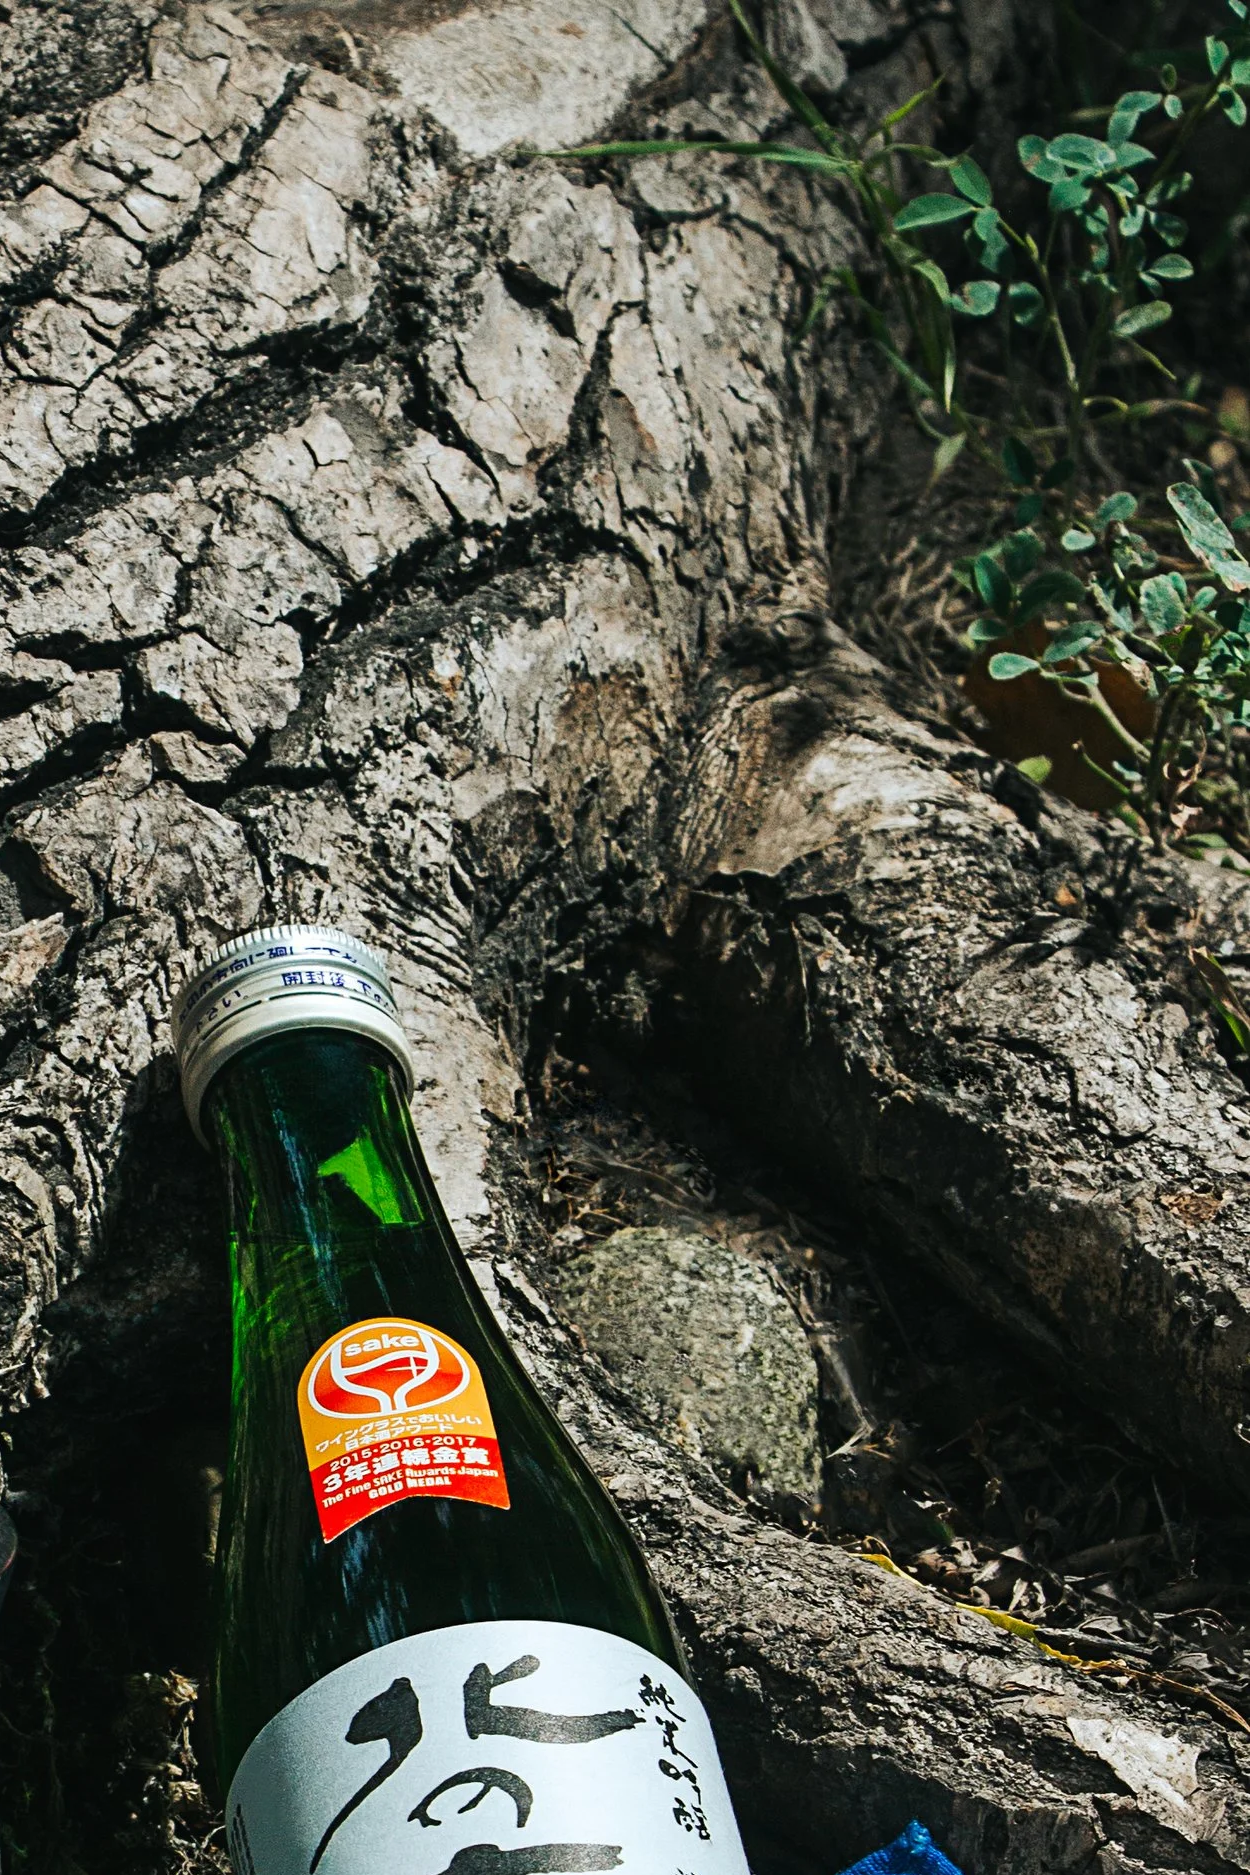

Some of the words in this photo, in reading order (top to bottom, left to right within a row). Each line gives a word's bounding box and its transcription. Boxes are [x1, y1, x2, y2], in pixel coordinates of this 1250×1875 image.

[344, 1334, 420, 1357] sake
[315, 1413, 482, 1453] ワイングラスでおいしい
[344, 1423, 454, 1451] 日本酒アワード
[322, 1491, 344, 1508] The
[345, 1481, 371, 1499] Fine
[373, 1470, 404, 1488] SAKE
[405, 1467, 455, 1477] Awards
[458, 1466, 499, 1478] Japan
[323, 1448, 490, 1493] 3年連続金賞
[369, 1481, 403, 1500] GOLD
[407, 1476, 452, 1489] MEDAL
